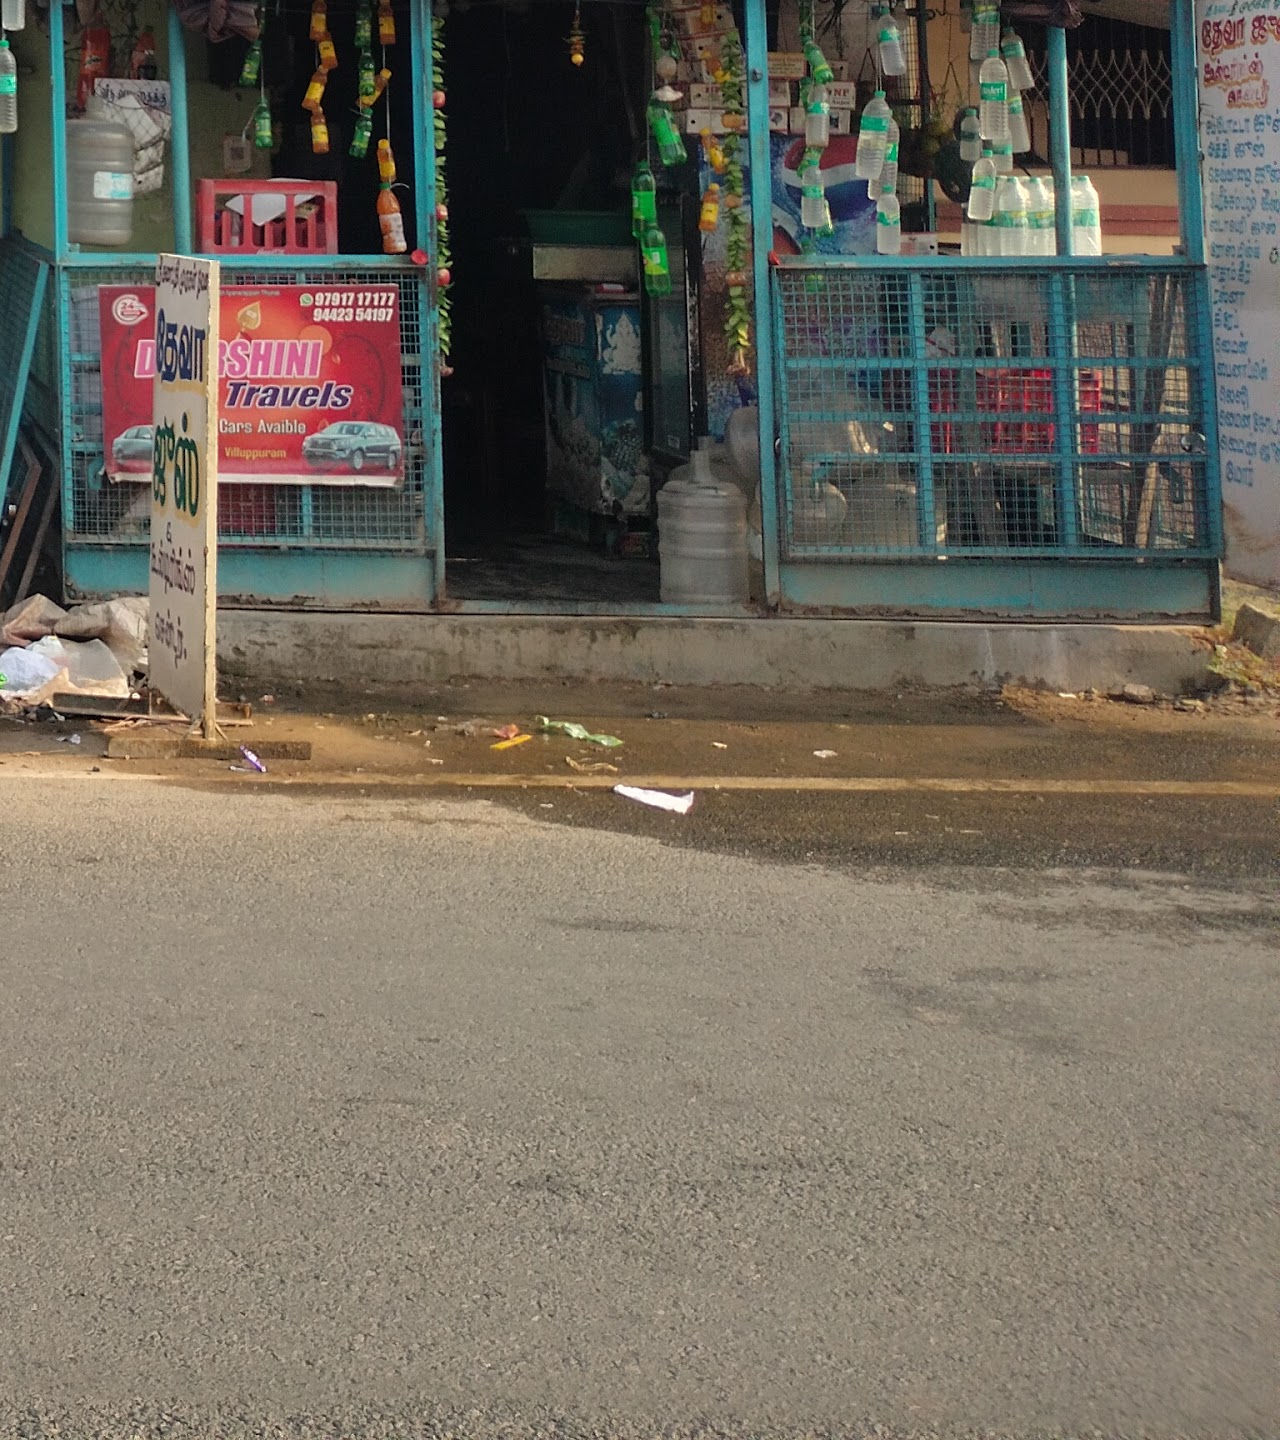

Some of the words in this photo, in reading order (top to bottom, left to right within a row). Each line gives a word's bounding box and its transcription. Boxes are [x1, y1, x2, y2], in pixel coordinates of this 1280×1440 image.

[1202, 18, 1245, 55] தேவா
[315, 292, 355, 306] 97917
[357, 292, 395, 306] 17177
[313, 308, 354, 322] 94423
[355, 307, 393, 322] 54197
[134, 339, 323, 379] DRSHINI
[156, 308, 206, 382] தேவா
[225, 380, 354, 409] Travels
[219, 418, 252, 434] Cars
[257, 418, 306, 434] Avaible
